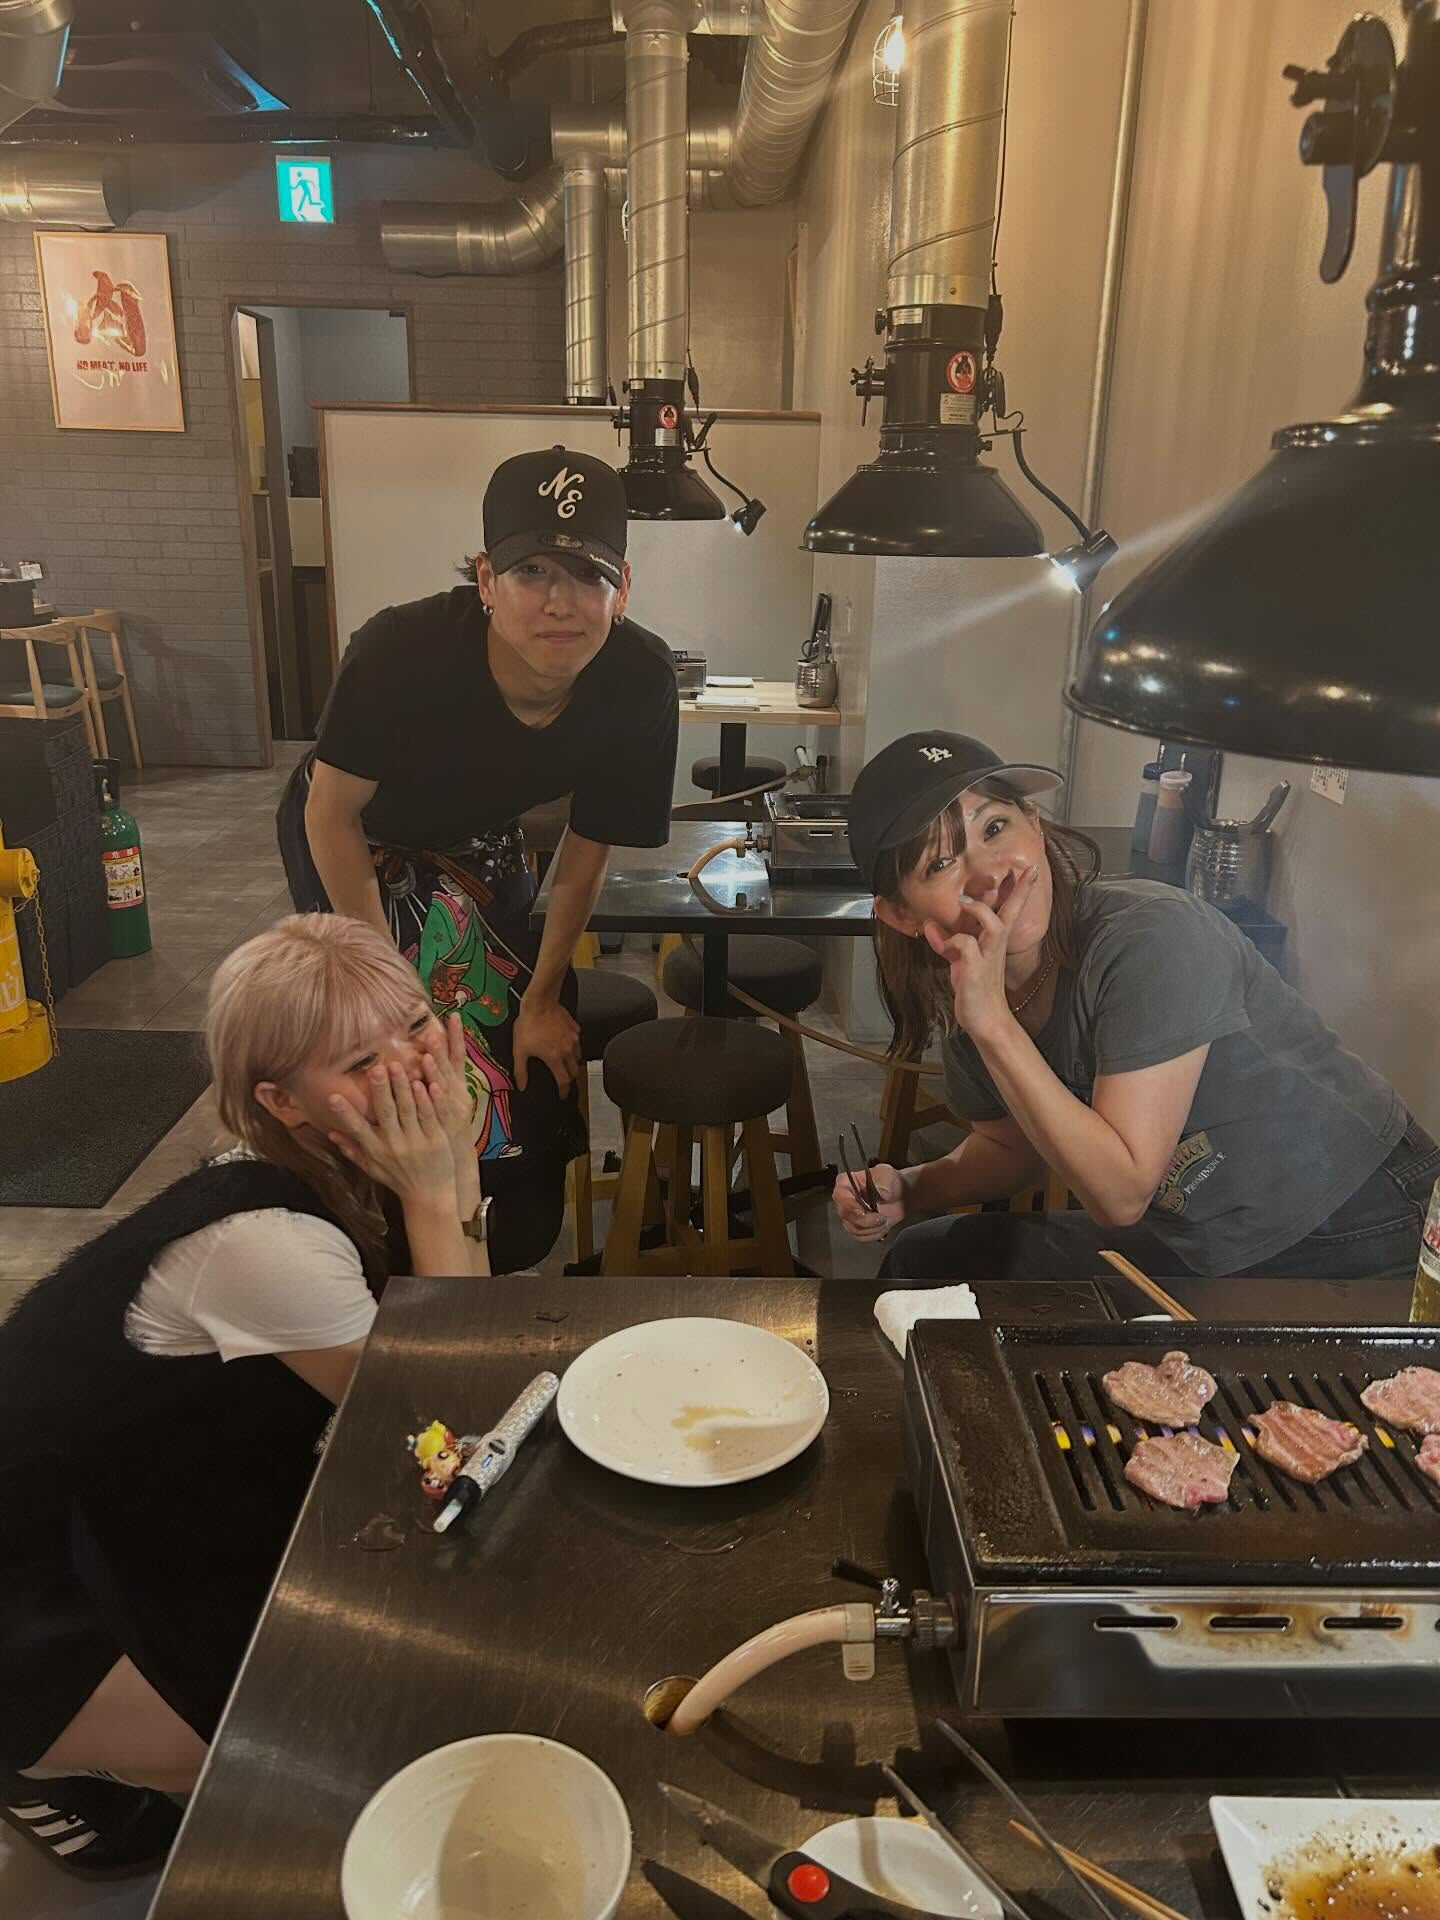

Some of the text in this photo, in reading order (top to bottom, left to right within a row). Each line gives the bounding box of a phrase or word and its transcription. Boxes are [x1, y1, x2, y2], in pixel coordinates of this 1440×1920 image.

[77, 360, 88, 370] NO
[119, 362, 130, 371] NO
[132, 362, 148, 372] LIFE
[1184, 1152, 1226, 1194] PROMINENCE
